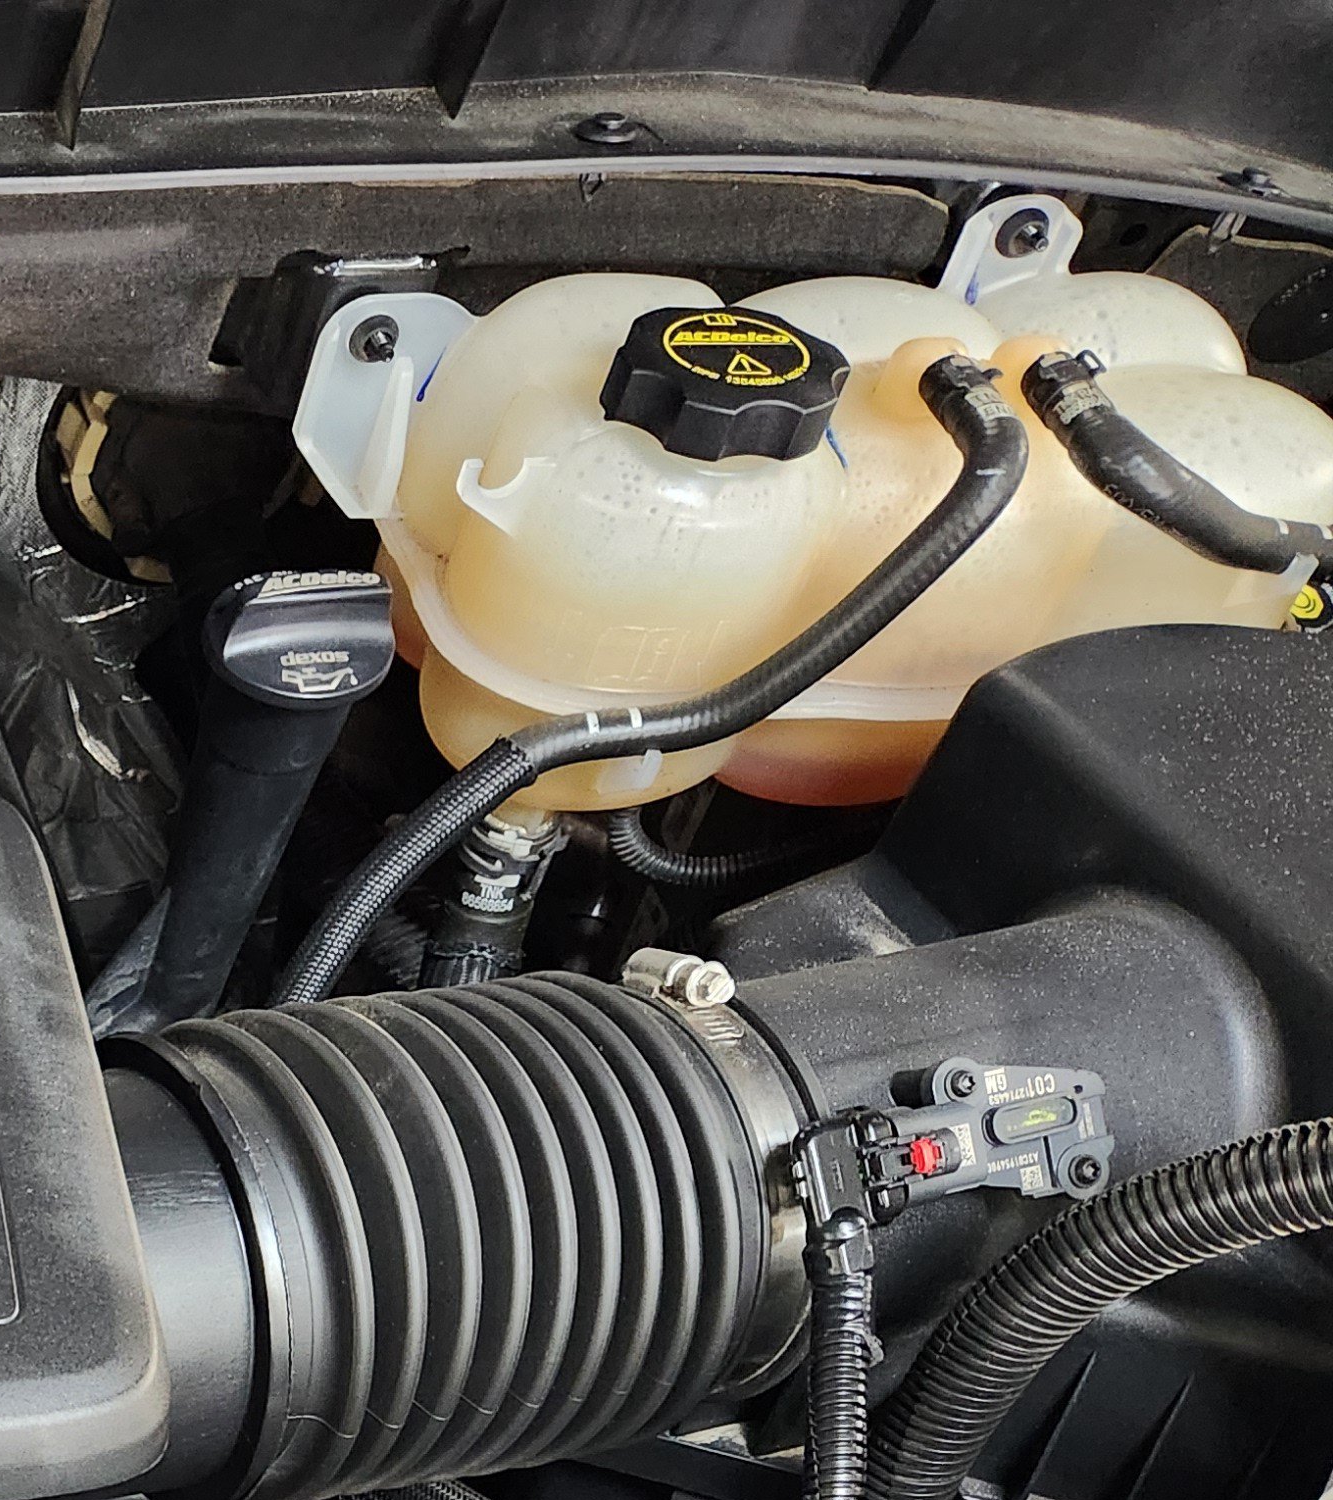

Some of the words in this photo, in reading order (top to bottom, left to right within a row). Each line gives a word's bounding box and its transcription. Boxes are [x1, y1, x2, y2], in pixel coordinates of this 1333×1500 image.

[672, 331, 791, 344] ACDelco
[261, 570, 381, 593] ACDelco
[280, 651, 350, 667] dexos
[480, 883, 506, 899] TNK
[985, 1074, 1007, 1094] GM
